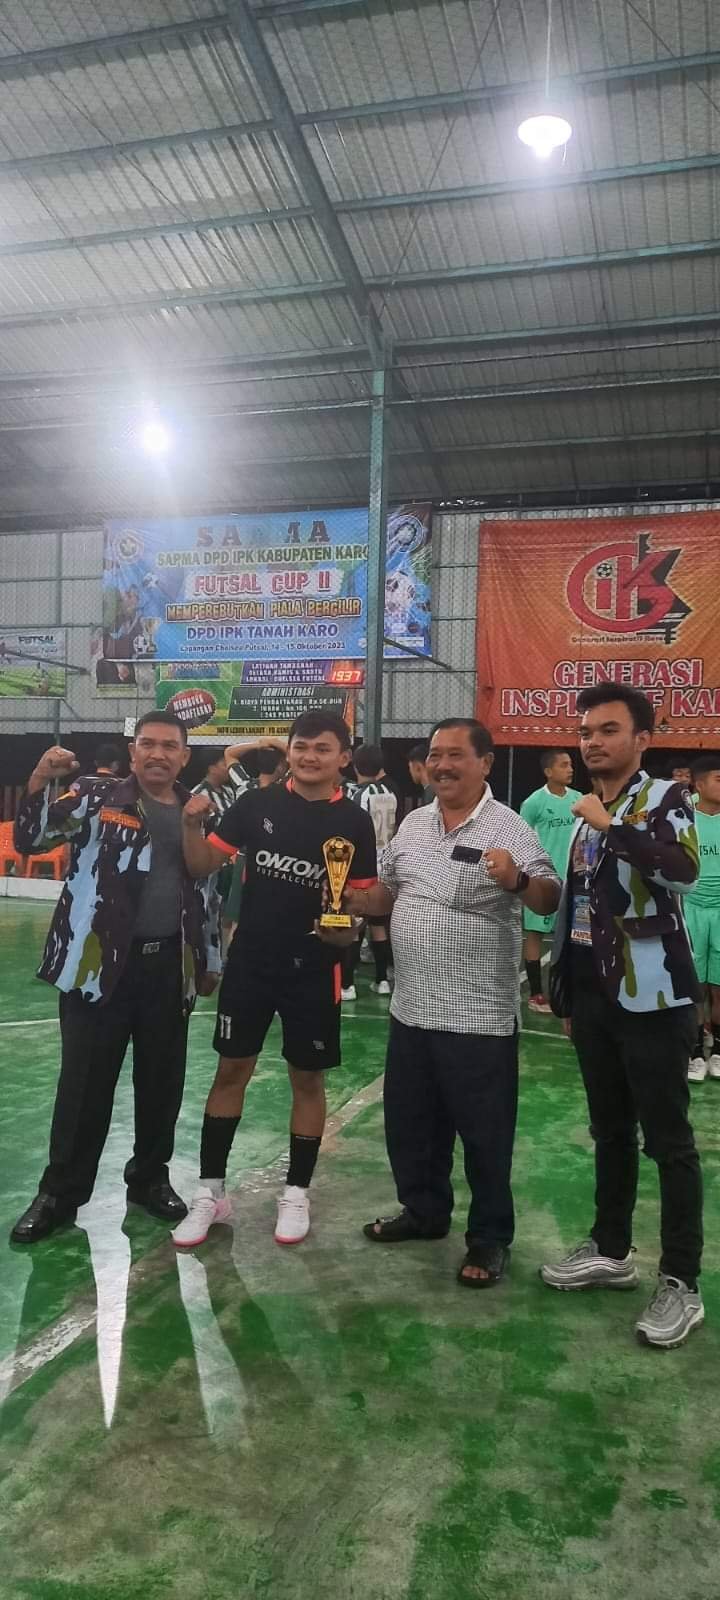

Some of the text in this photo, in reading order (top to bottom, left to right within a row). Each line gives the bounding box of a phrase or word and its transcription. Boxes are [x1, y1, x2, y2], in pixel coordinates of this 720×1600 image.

[157, 551, 201, 567] SAPMA
[203, 550, 230, 565] DPD
[232, 549, 255, 563] IPK
[257, 546, 332, 562] KABUPATEN
[194, 570, 331, 596] FUTSAL CUP II
[166, 597, 361, 622] MEMPEREBUTKAN PIALA BERGILIR
[187, 623, 339, 640] DPD IPK TANAH KARO
[180, 644, 214, 653] Lapangan
[296, 642, 325, 650] Oktober
[553, 659, 703, 689] GENERASI
[261, 687, 316, 697] ADMINISTRASI
